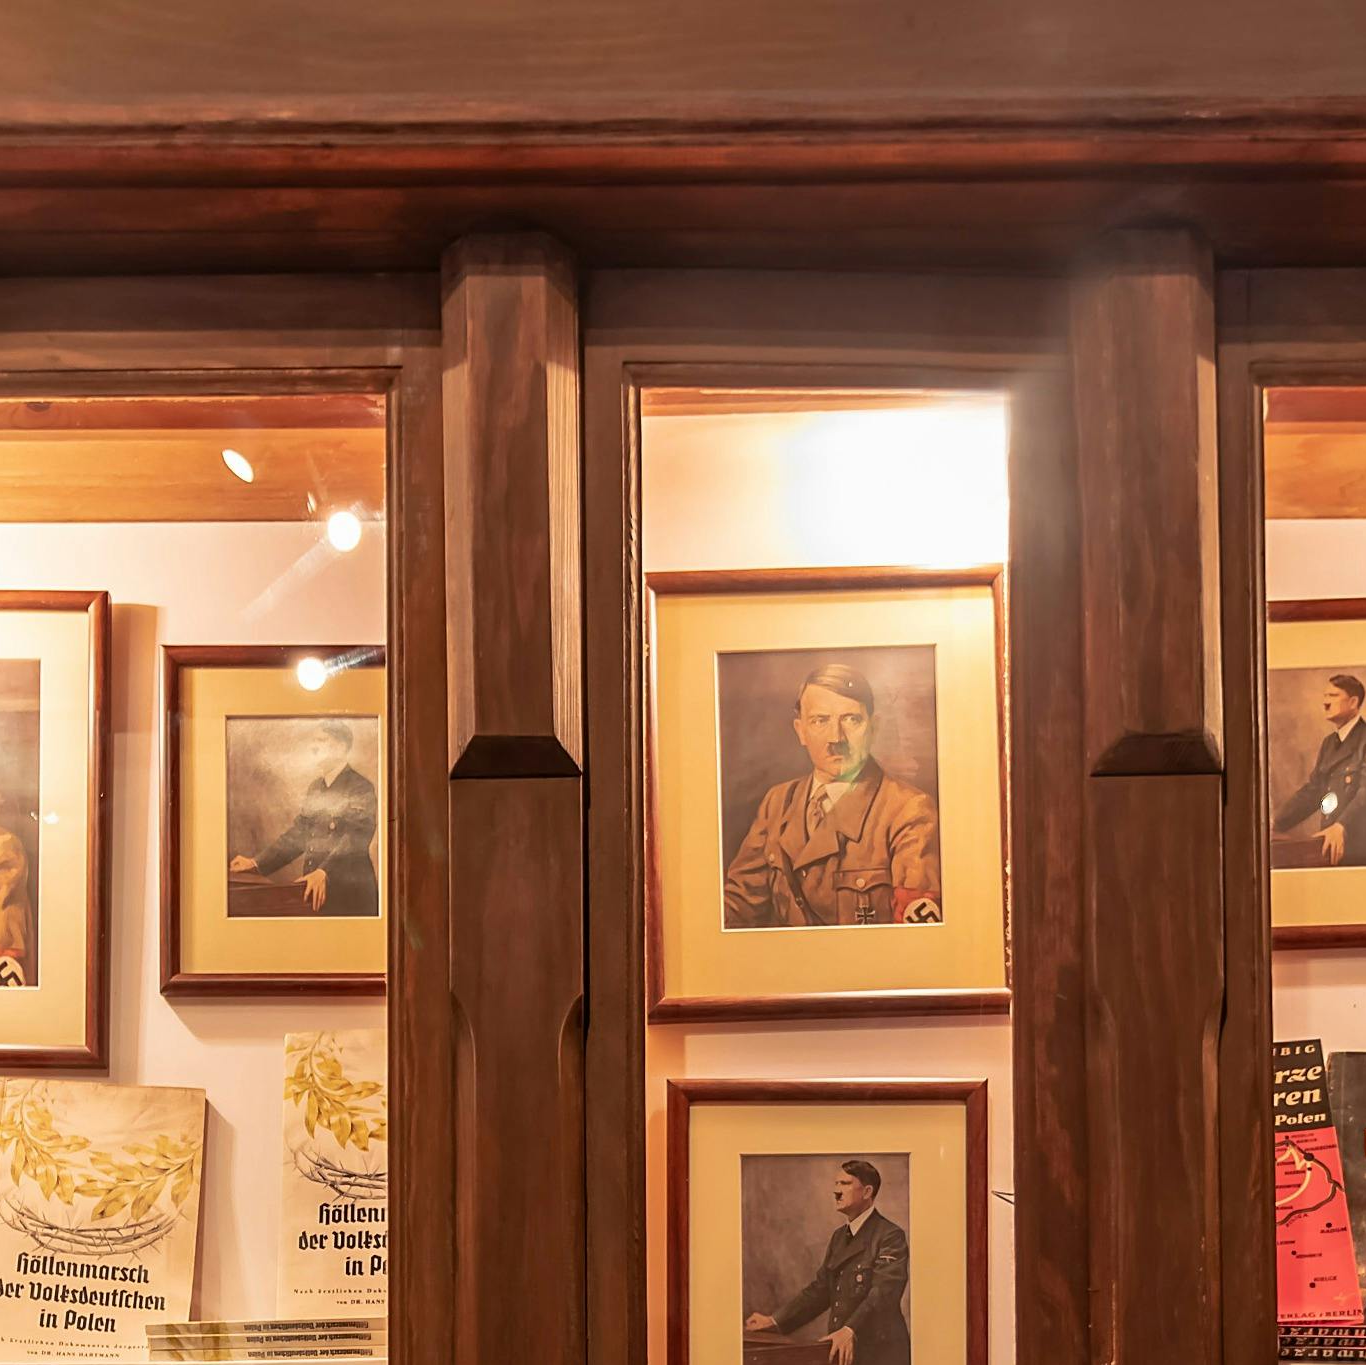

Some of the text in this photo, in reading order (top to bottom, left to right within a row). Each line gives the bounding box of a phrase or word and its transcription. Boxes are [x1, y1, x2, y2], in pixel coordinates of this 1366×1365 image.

[1275, 1112, 1326, 1126] Polen
[16, 1251, 150, 1284] Höllenmarsch
[39, 1308, 116, 1333] in Polen
